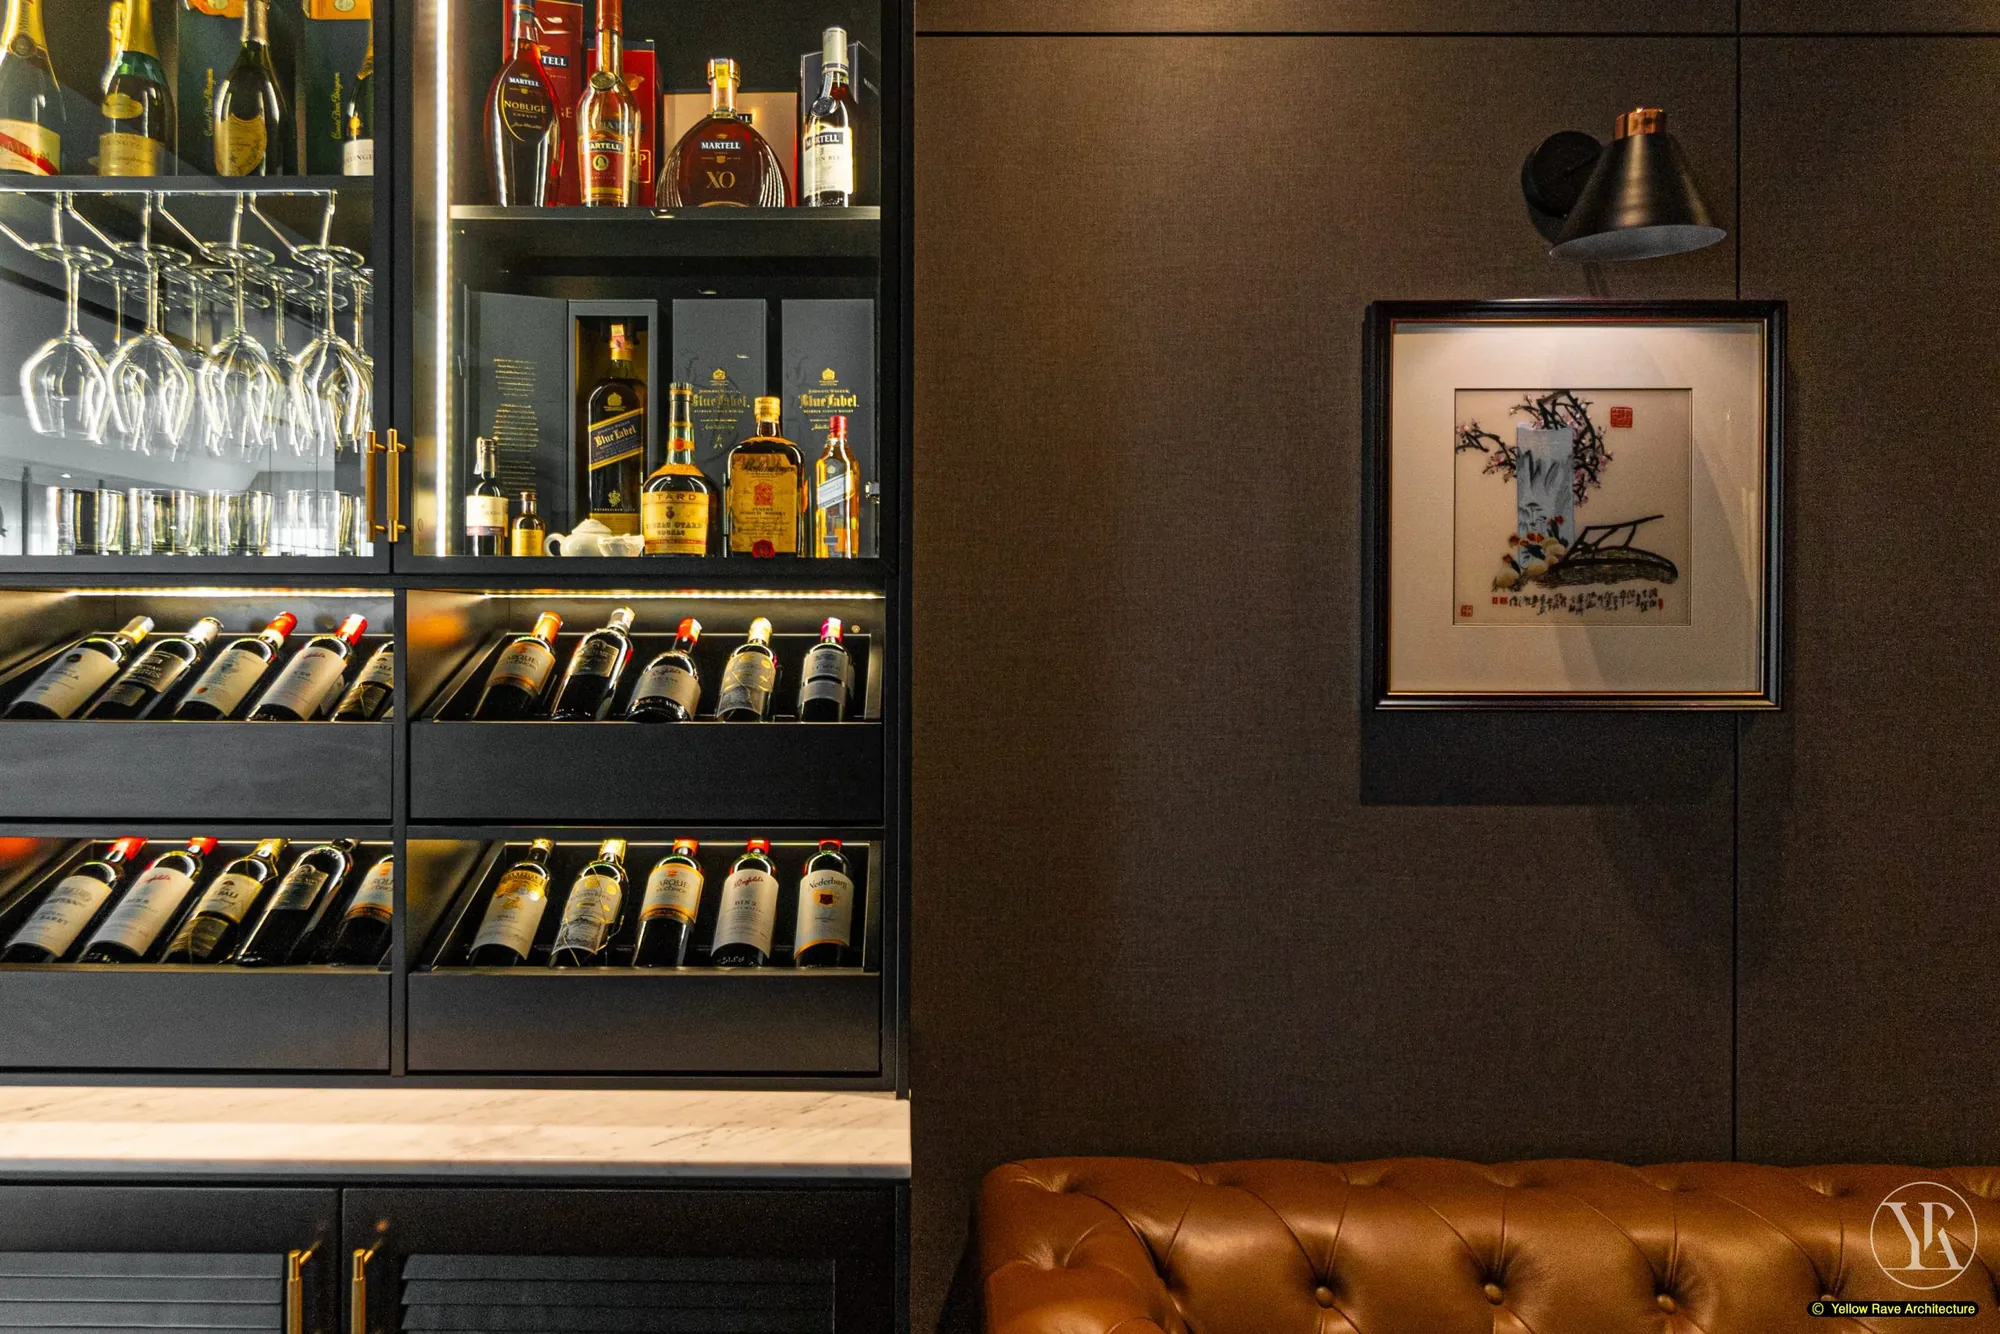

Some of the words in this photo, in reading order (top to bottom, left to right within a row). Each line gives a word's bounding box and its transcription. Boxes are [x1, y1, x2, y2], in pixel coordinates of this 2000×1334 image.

[542, 55, 567, 66] TELL
[508, 76, 541, 87] MARTELL
[503, 99, 547, 113] NOBLIGE
[701, 141, 741, 150] MARTELL
[806, 133, 840, 146] MRTELL
[590, 142, 620, 151] ARTELL
[705, 171, 736, 189] XO
[801, 394, 826, 407] Blue
[594, 432, 614, 448] Blue
[614, 424, 637, 441] Label
[650, 493, 697, 501] TARD
